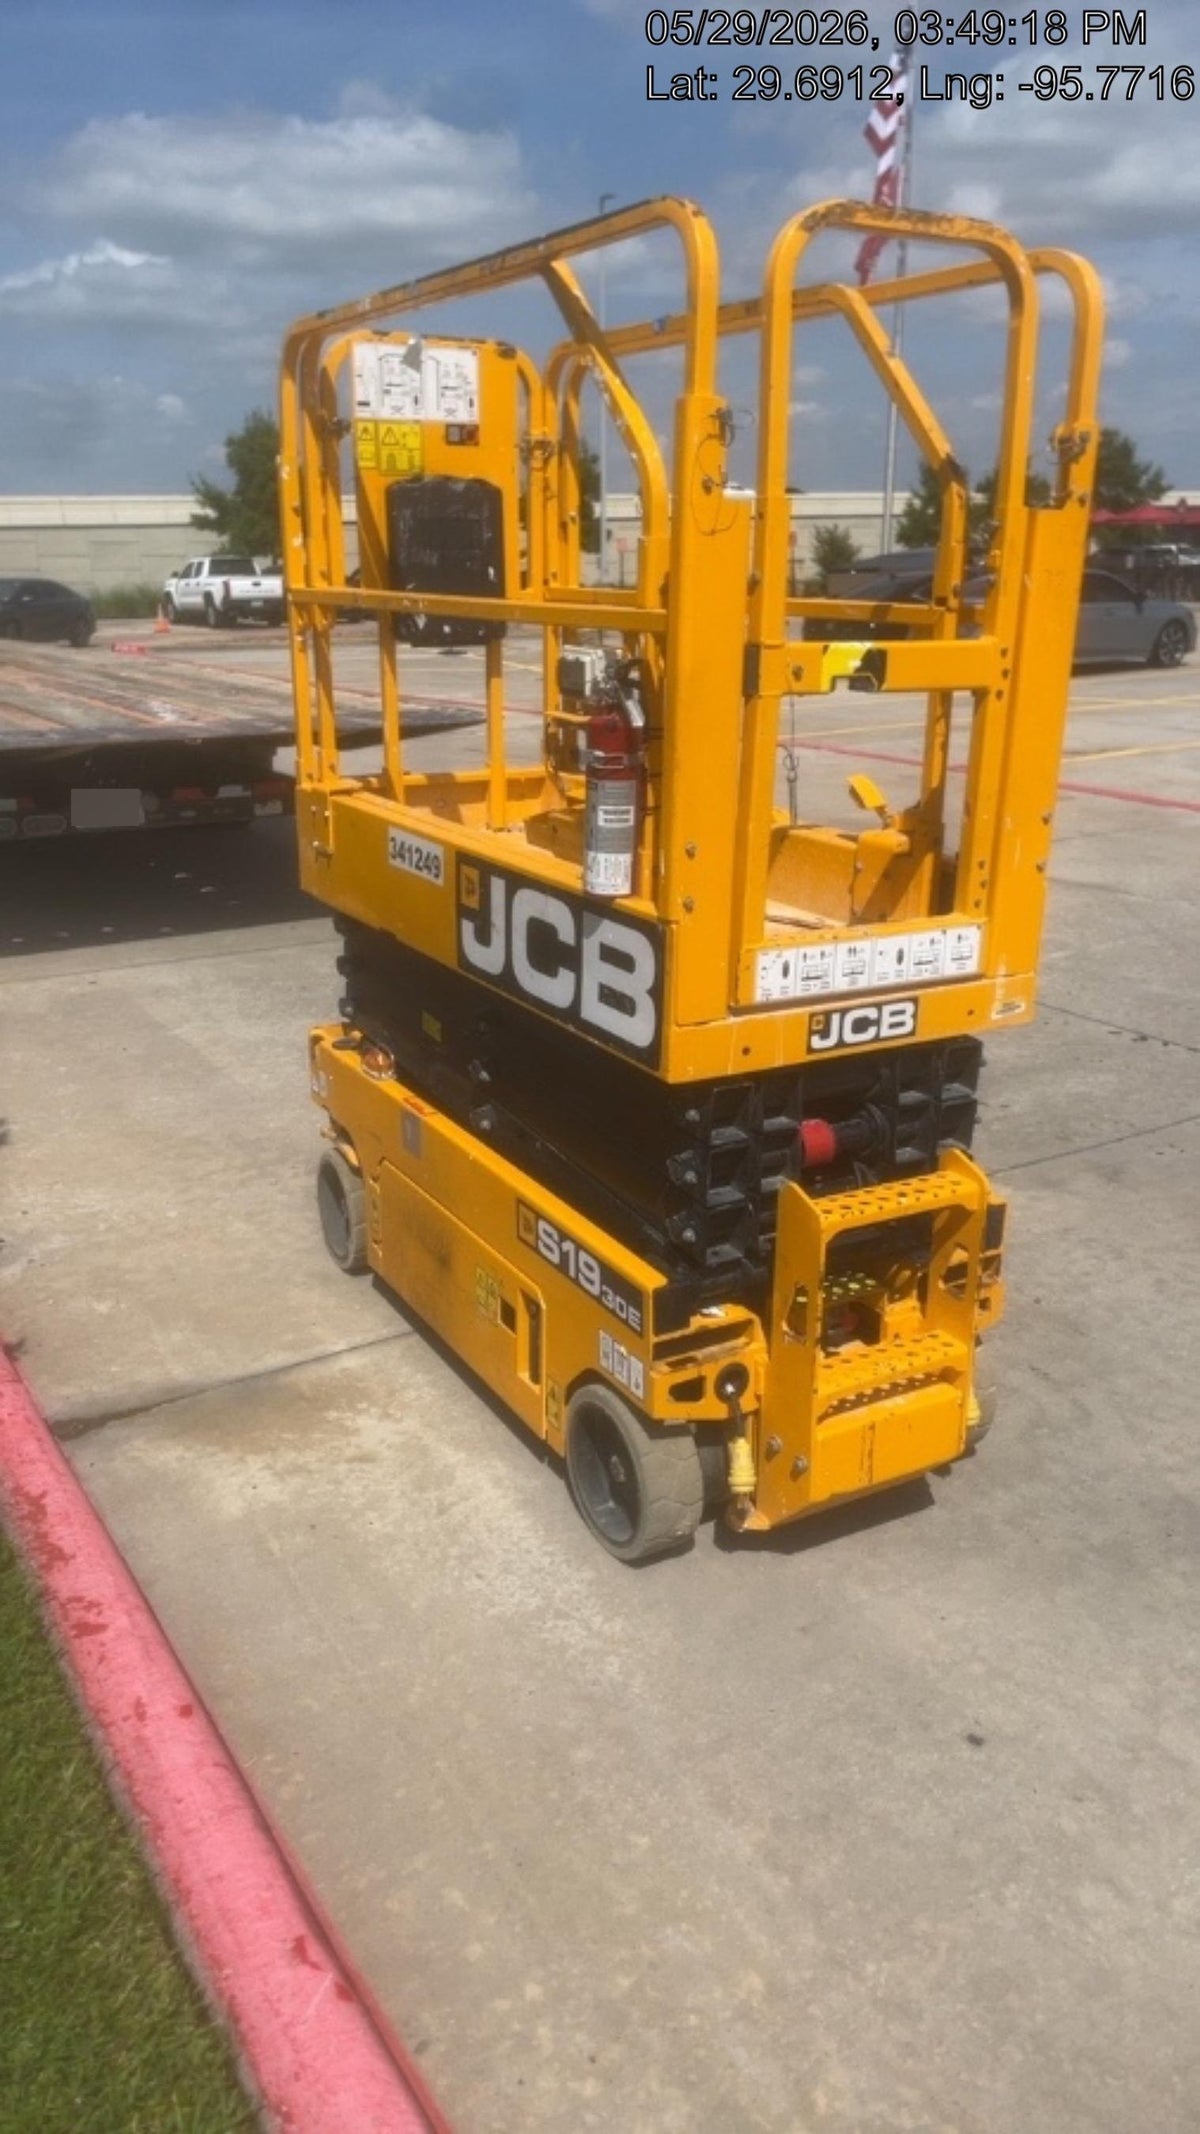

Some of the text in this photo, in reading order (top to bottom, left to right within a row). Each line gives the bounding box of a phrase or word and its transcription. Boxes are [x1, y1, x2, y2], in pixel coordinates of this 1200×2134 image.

[389, 836, 442, 879] 341249
[461, 875, 656, 1048] JCB
[810, 1001, 916, 1050] JCB
[537, 1218, 601, 1296] S19
